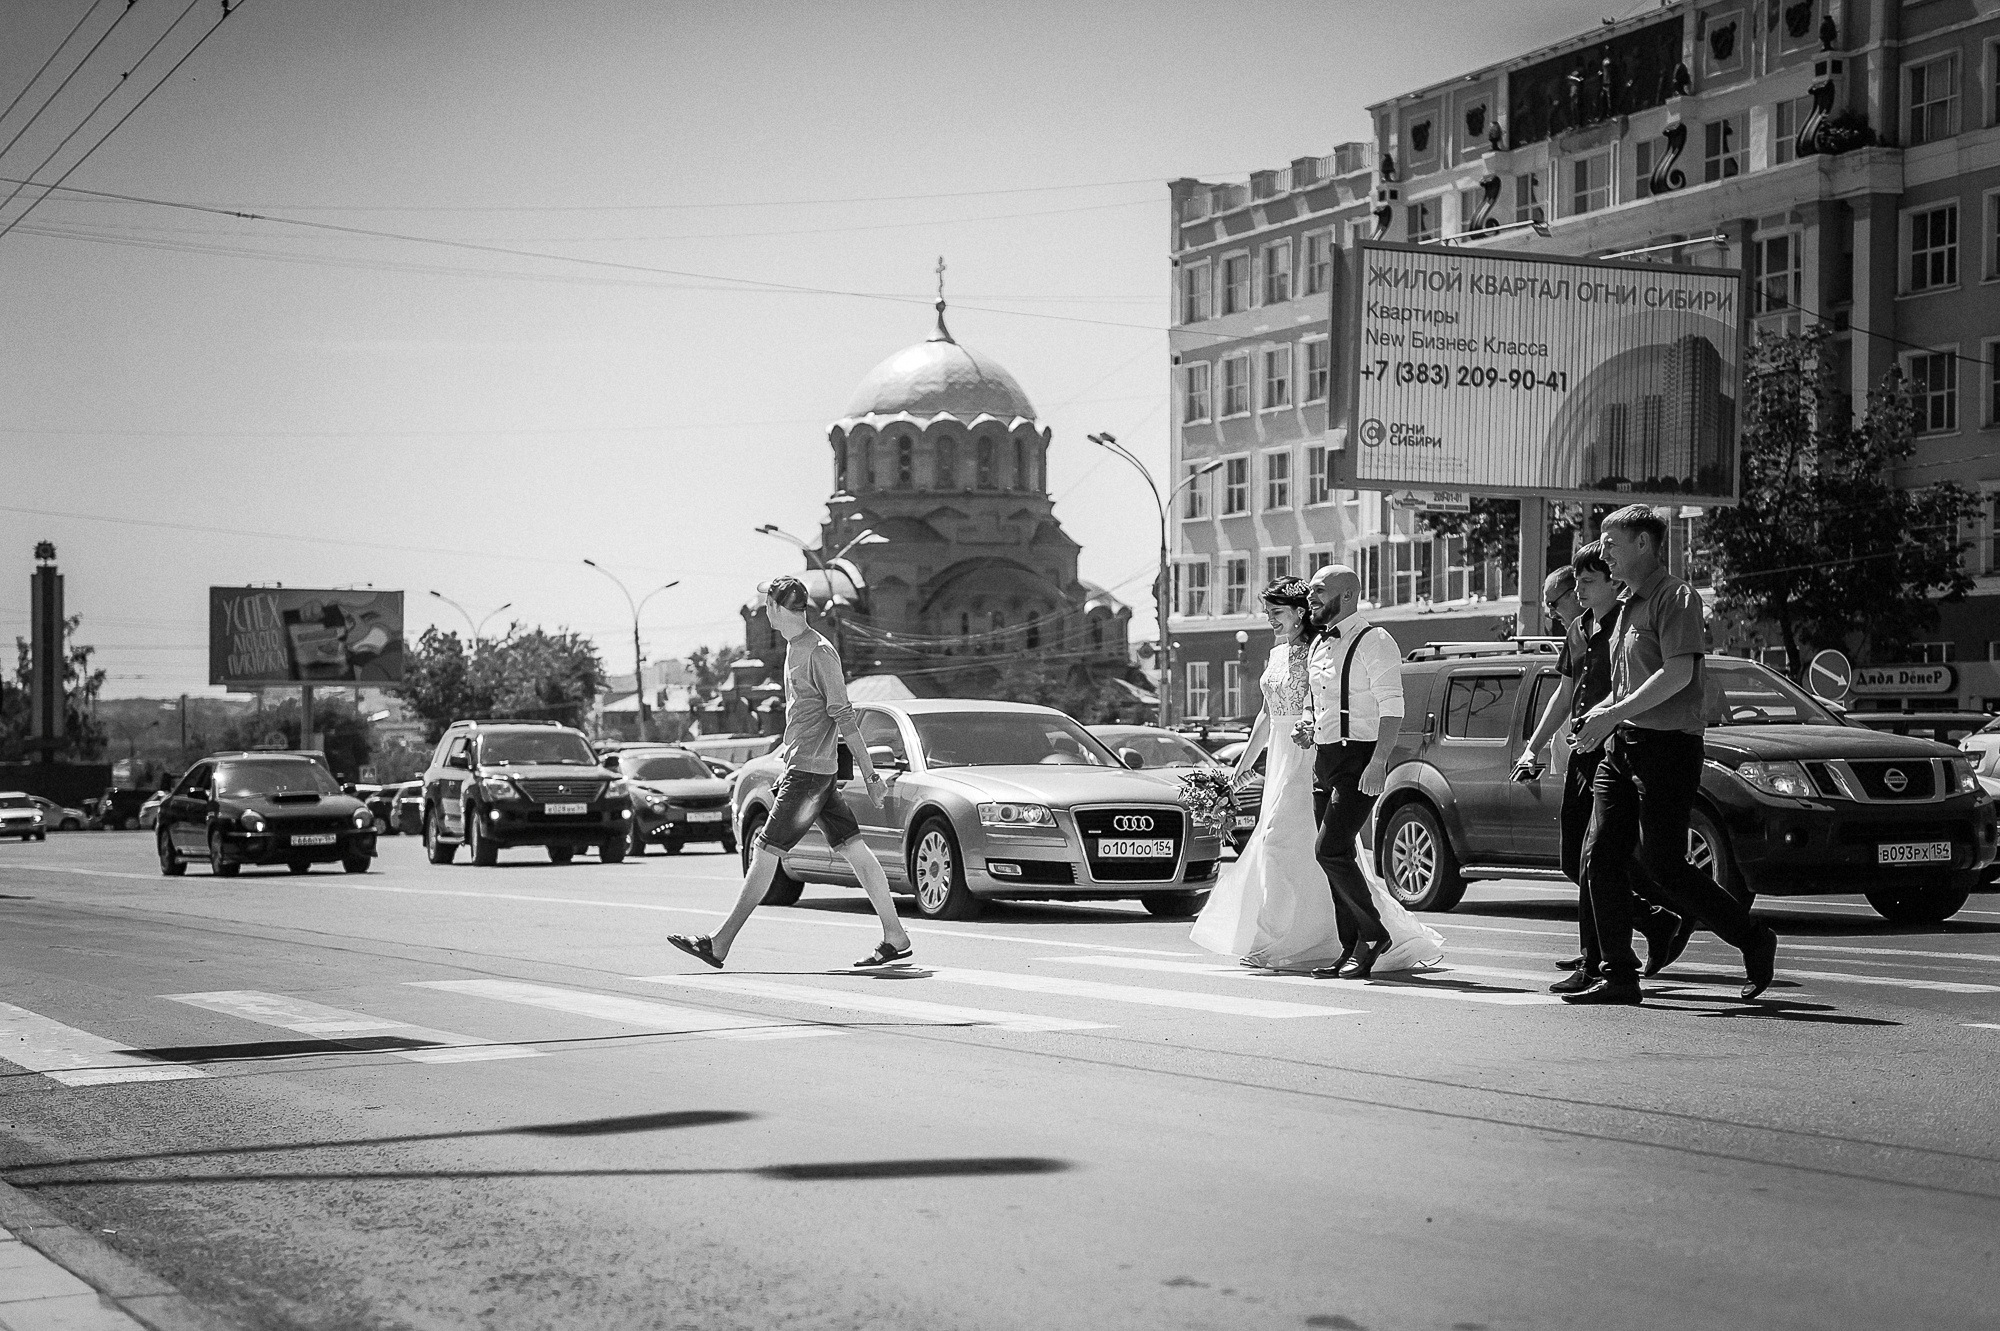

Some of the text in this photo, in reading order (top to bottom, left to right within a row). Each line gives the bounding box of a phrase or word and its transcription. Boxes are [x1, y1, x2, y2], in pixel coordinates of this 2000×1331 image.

[1368, 264, 1733, 311] ЖИЛОЙ КВАРТАЛ ОГНИ СИБИРИ
[1367, 301, 1459, 326] Квартиры
[1366, 328, 1549, 357] New Бизнес Класса
[1361, 360, 1567, 392] +7 (383) 209-90-41
[1390, 422, 1425, 435] ОГНИ
[1390, 435, 1442, 448] СИБИРИ
[223, 593, 281, 636] УСПЕХ
